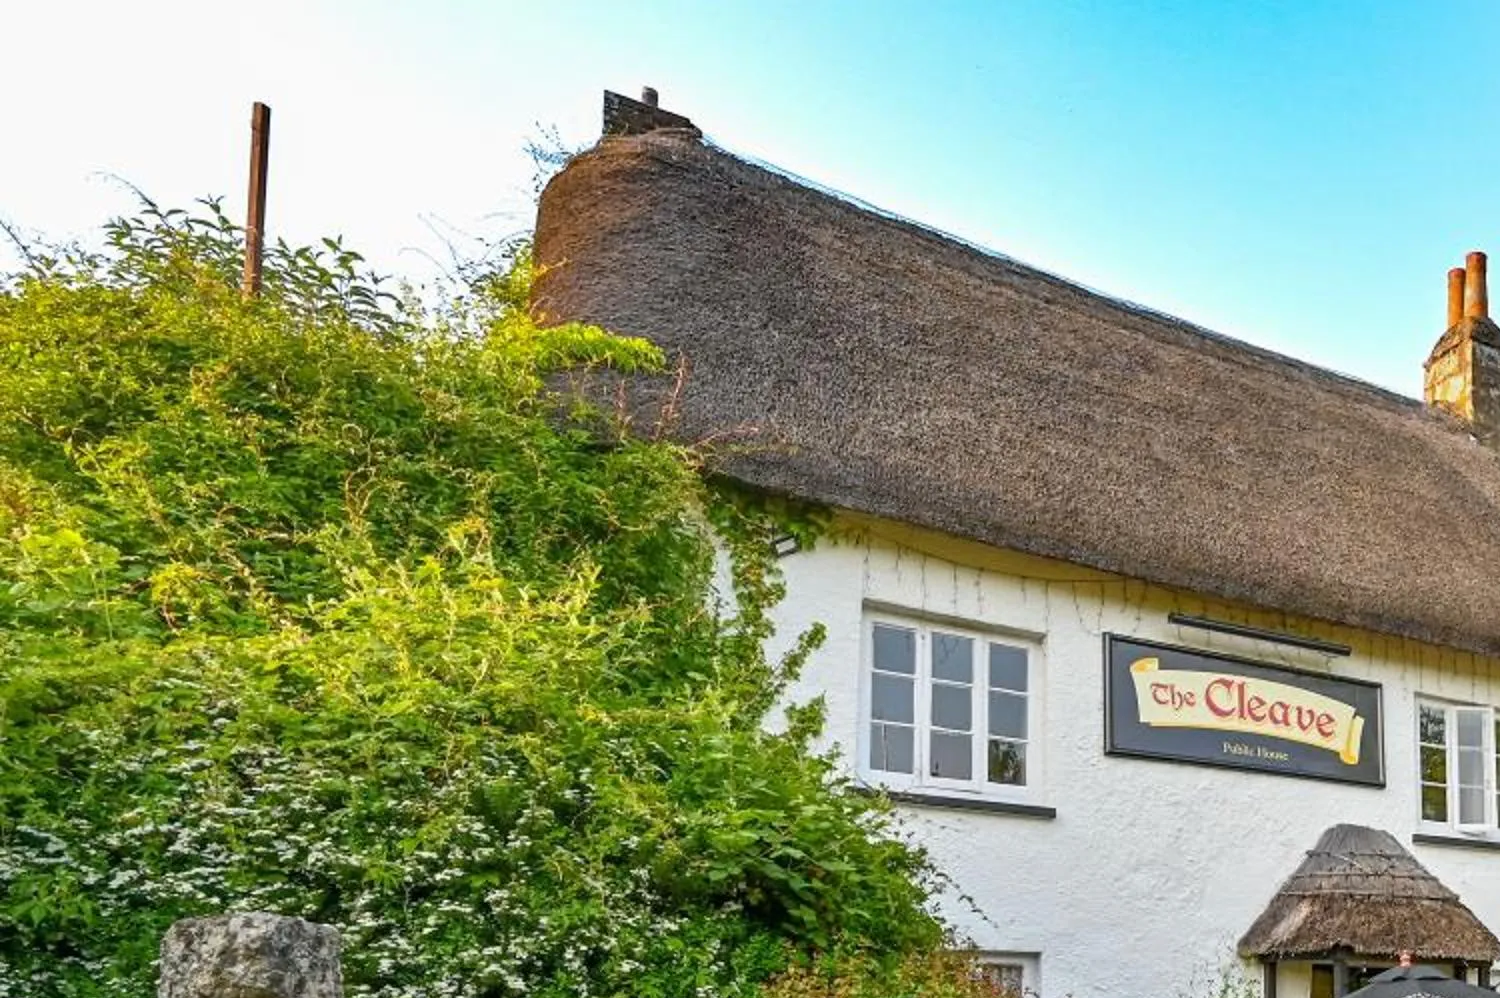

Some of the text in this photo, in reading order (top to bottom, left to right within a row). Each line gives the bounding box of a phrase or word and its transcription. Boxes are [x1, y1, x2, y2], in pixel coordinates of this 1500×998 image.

[1150, 677, 1336, 738] The Cleave
[1257, 745, 1289, 761] House
